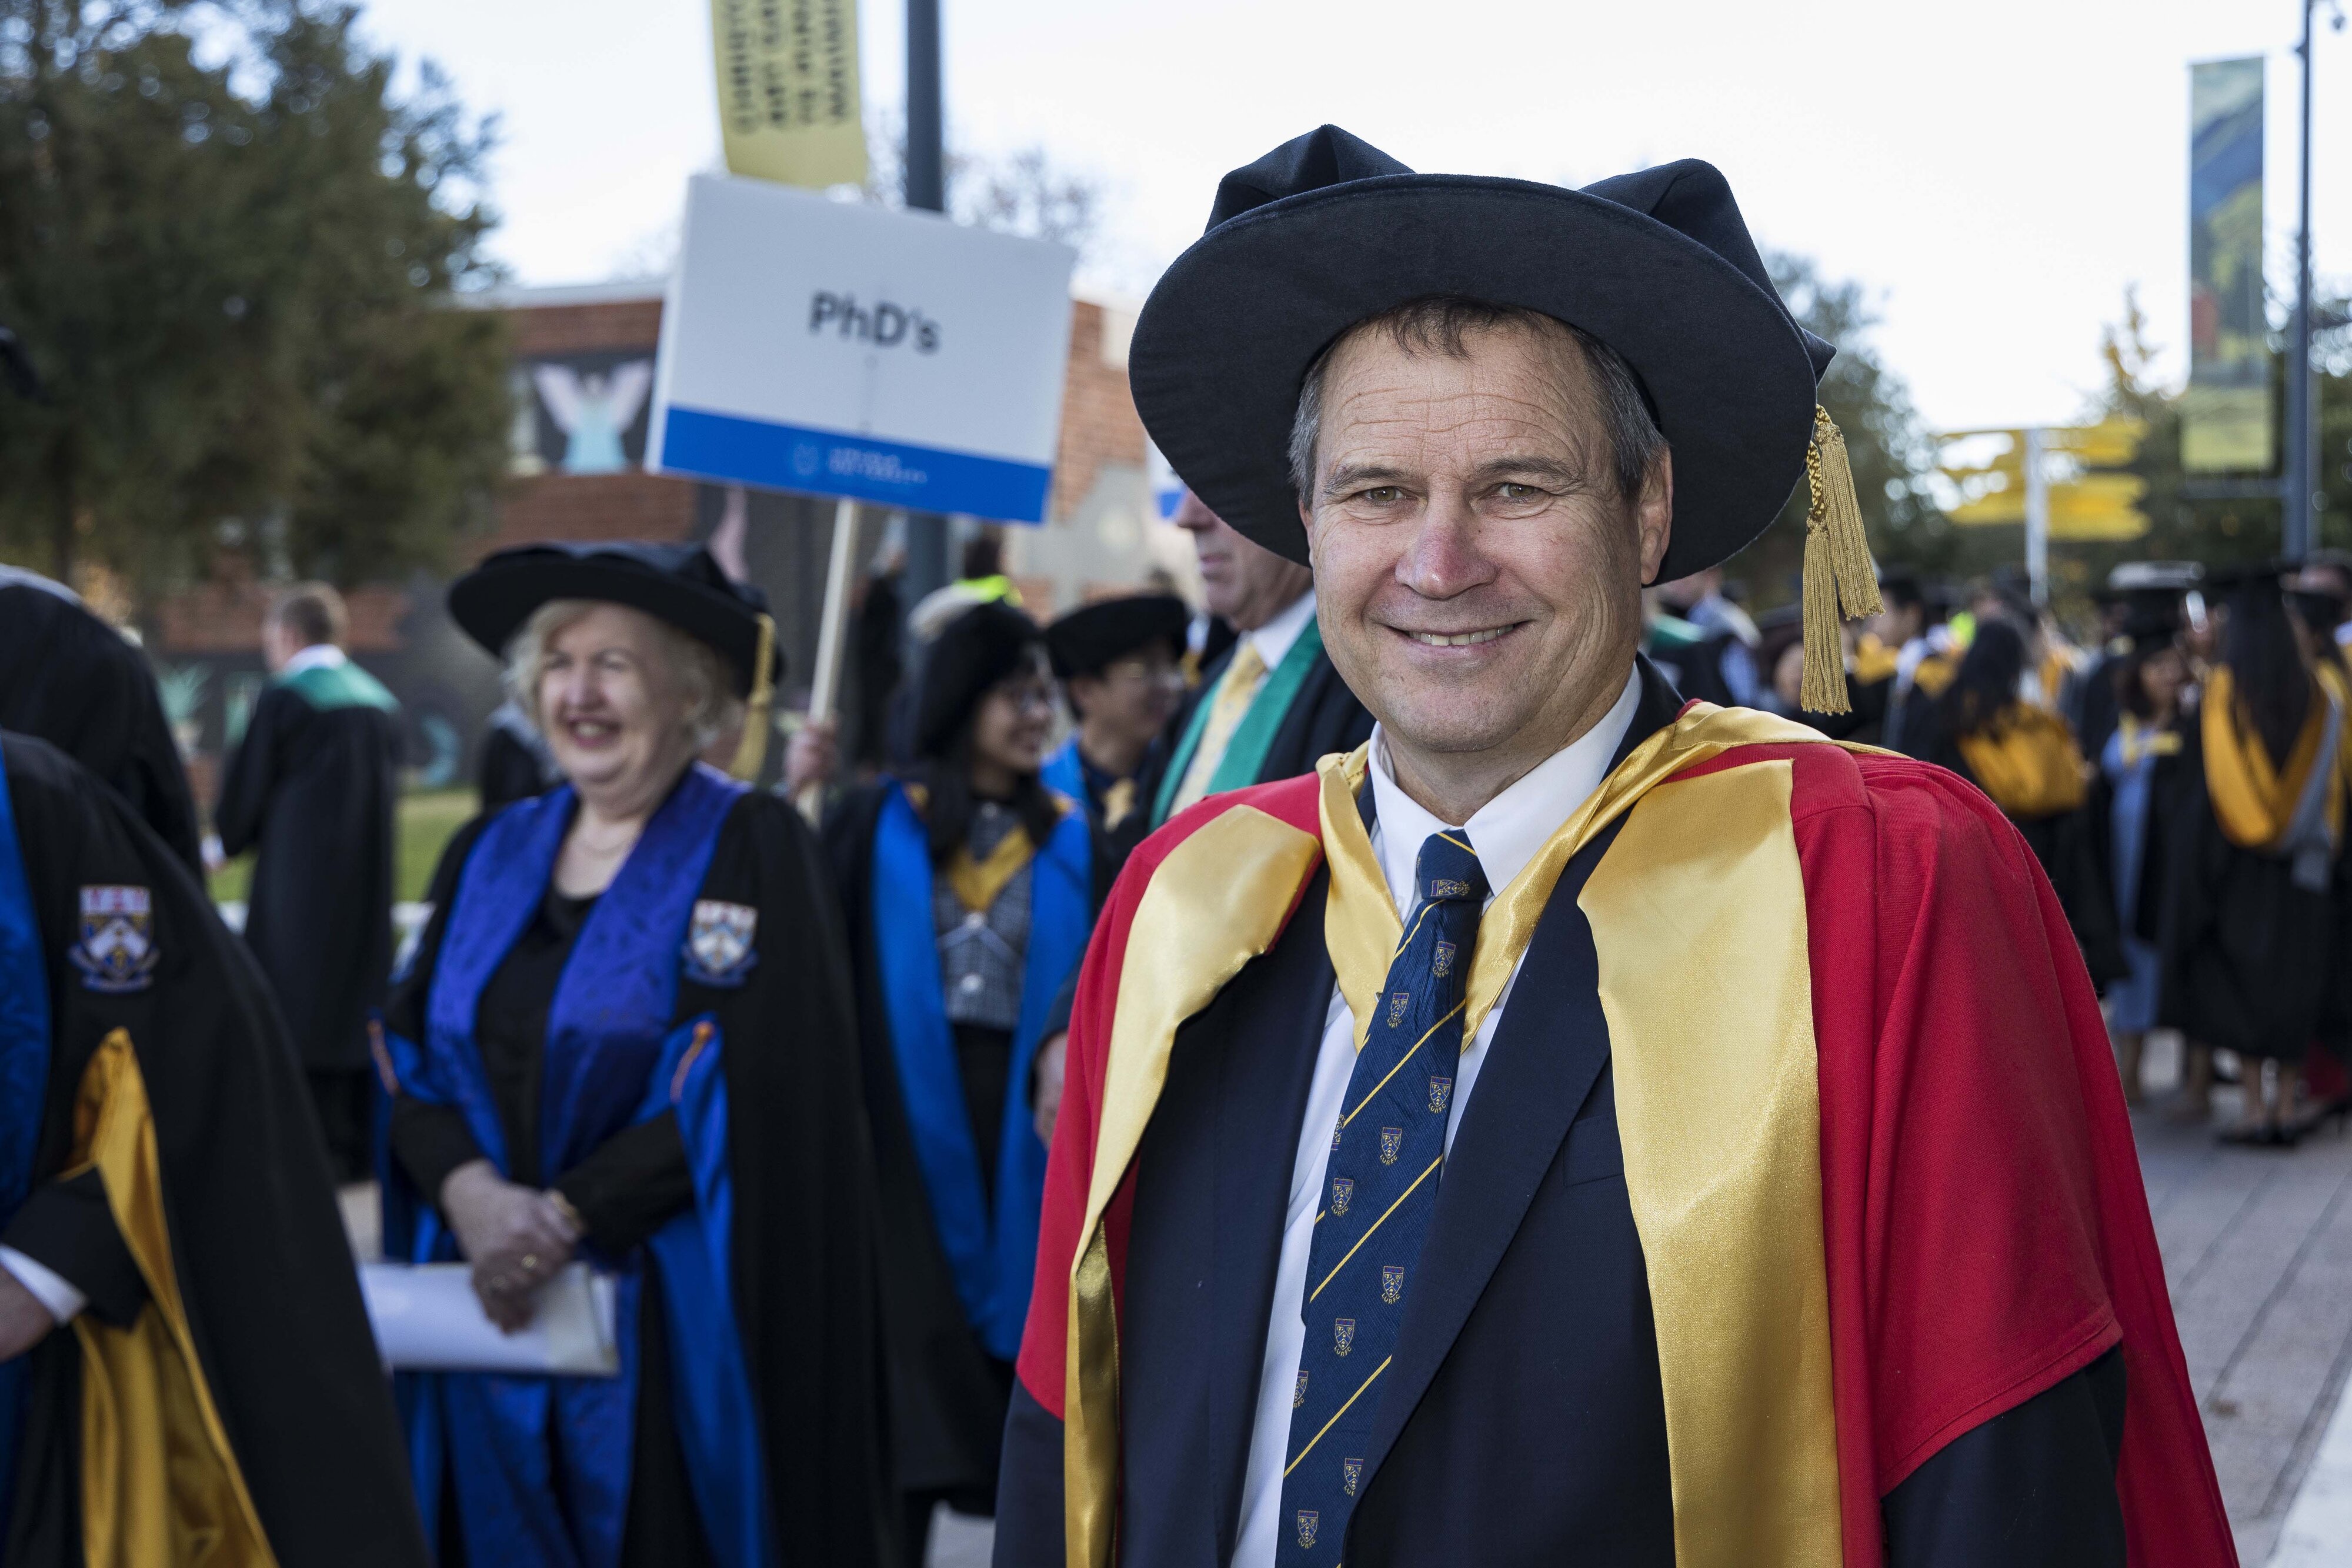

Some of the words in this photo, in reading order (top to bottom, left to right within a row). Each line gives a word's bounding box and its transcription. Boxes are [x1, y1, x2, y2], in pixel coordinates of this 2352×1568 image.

[809, 291, 942, 354] PhD's
[1432, 966, 1449, 978] LURFC
[1387, 1017, 1402, 1028] LURFC
[1428, 1102, 1446, 1113] LURFC
[1379, 1154, 1397, 1165] LURFC
[1331, 1205, 1349, 1216] LURFC
[1382, 1293, 1400, 1304] LURFC
[1334, 1345, 1352, 1357] LURFC
[1297, 1536, 1316, 1549] LURFC
